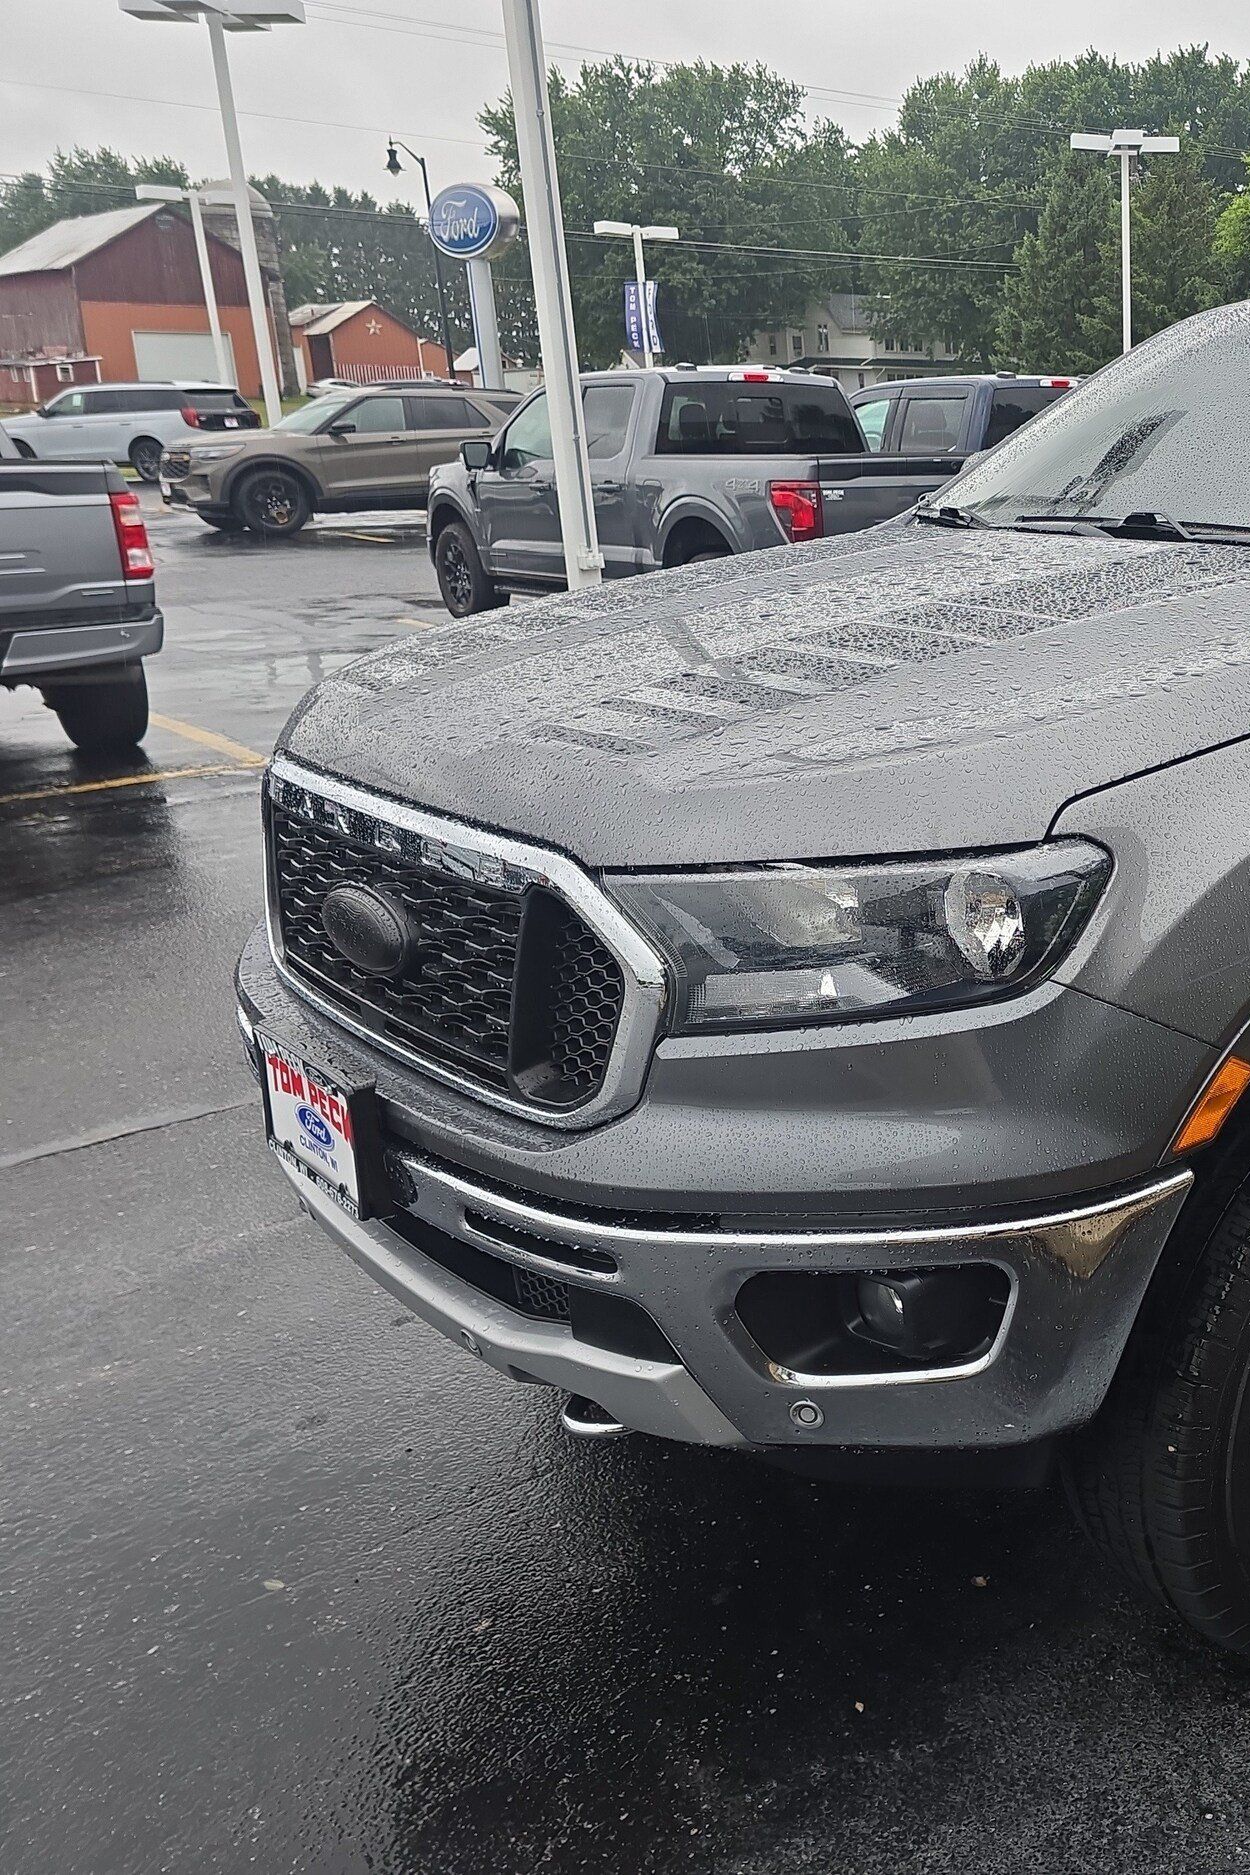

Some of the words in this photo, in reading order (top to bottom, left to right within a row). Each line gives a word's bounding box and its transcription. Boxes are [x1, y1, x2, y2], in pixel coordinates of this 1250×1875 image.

[440, 199, 481, 243] Ford
[628, 286, 637, 311] TOM
[630, 316, 640, 348] PECK
[268, 1054, 306, 1102] TOM
[304, 1110, 327, 1143] Ford
